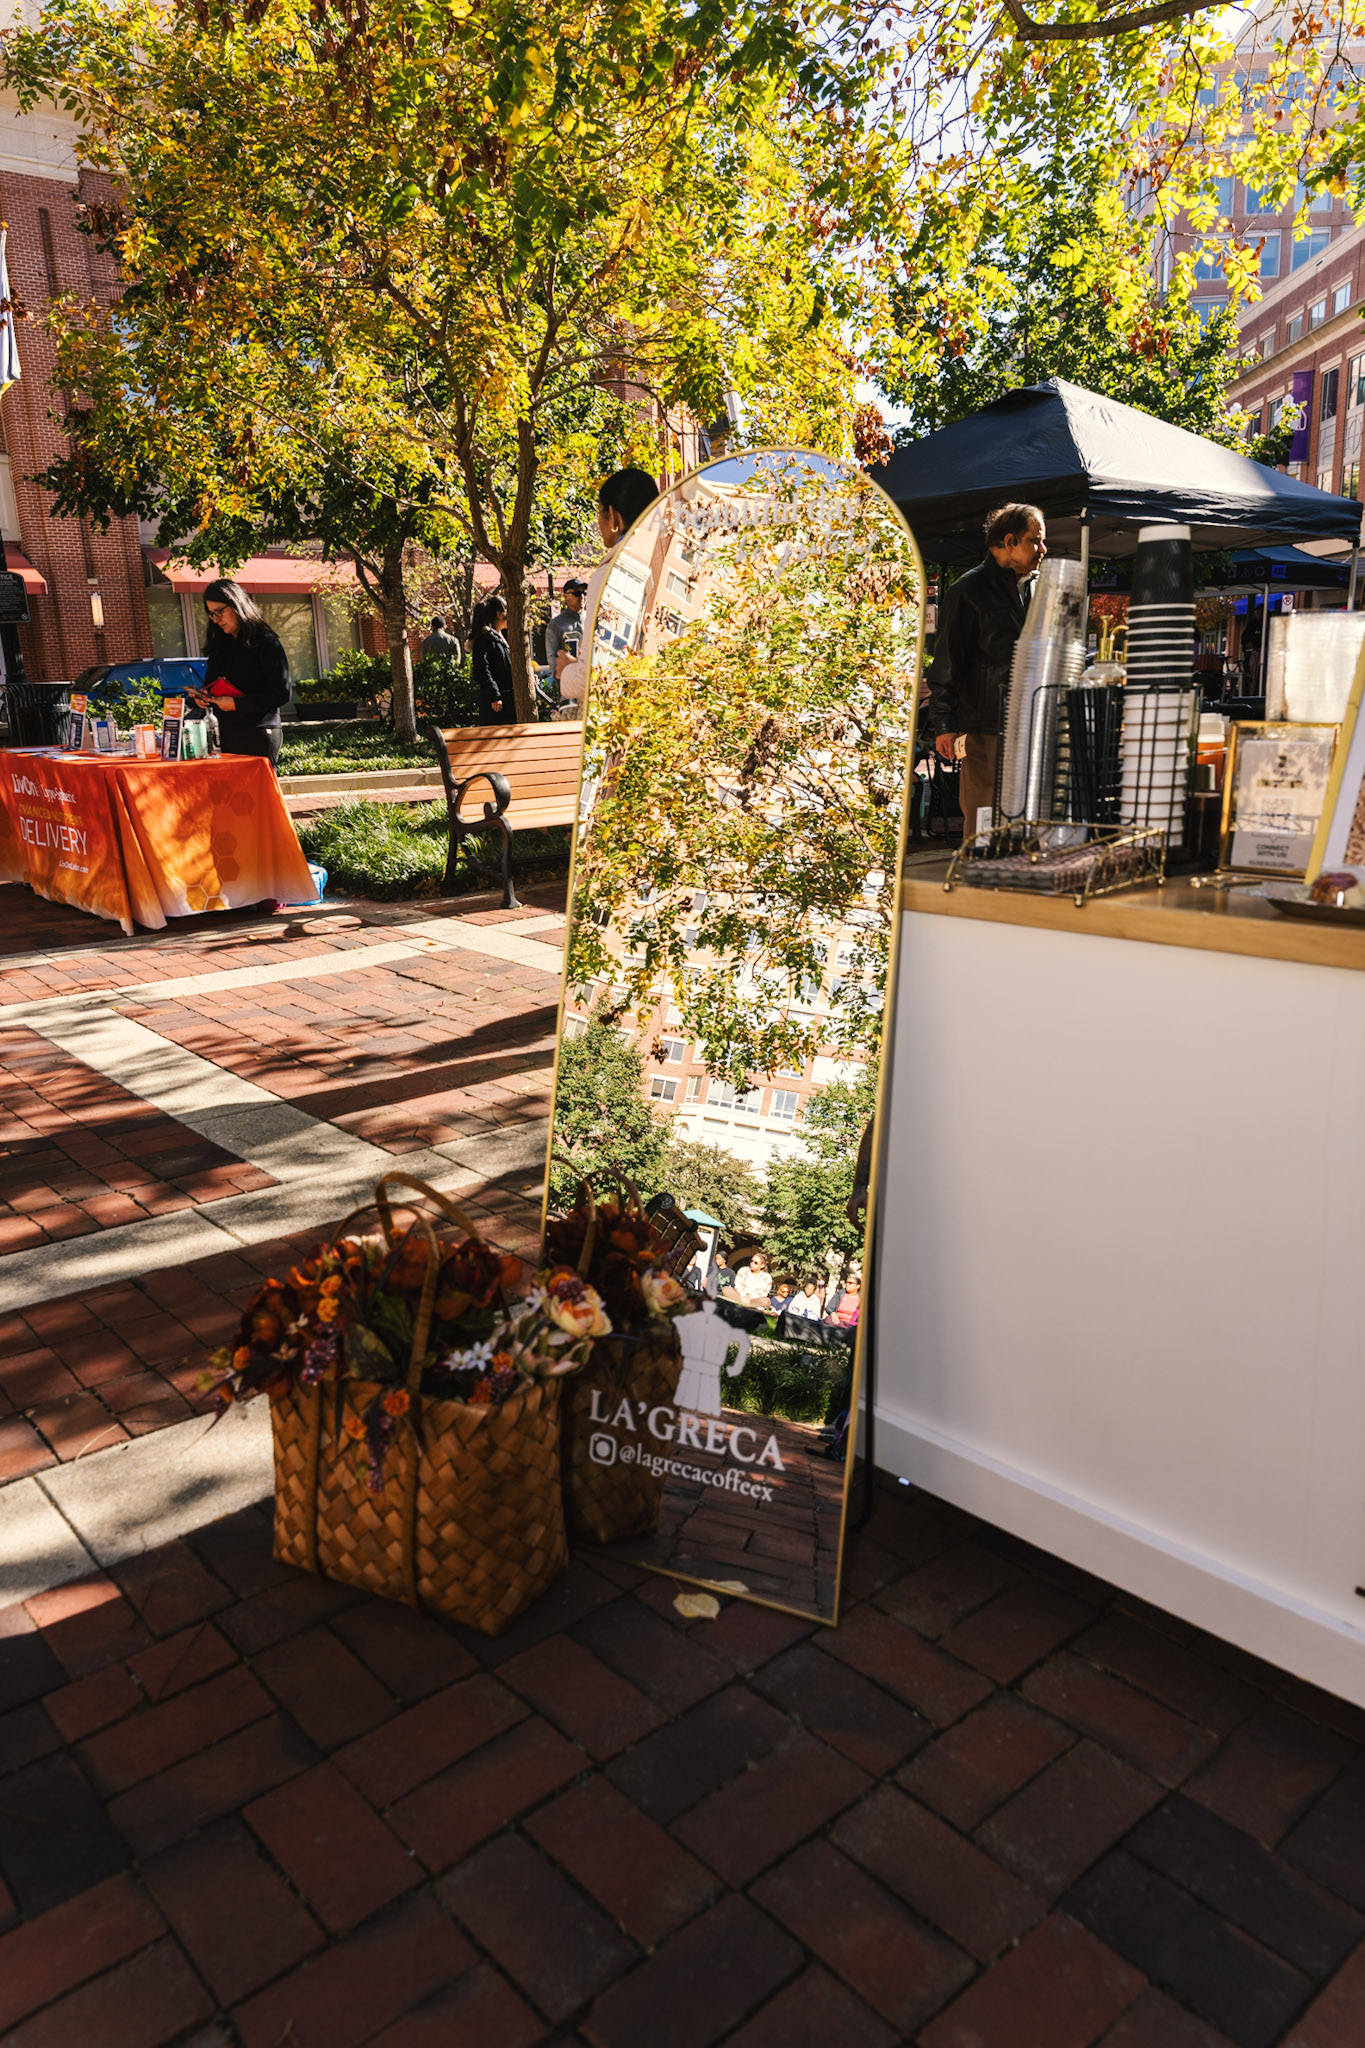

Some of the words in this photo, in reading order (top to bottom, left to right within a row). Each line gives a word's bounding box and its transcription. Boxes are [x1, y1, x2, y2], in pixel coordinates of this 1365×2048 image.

[676, 492, 799, 530] beautiful
[808, 488, 862, 526] day
[11, 773, 39, 796] LivOn
[19, 816, 87, 856] DELIVERY
[619, 1441, 775, 1503] @lagrecacoffeex
